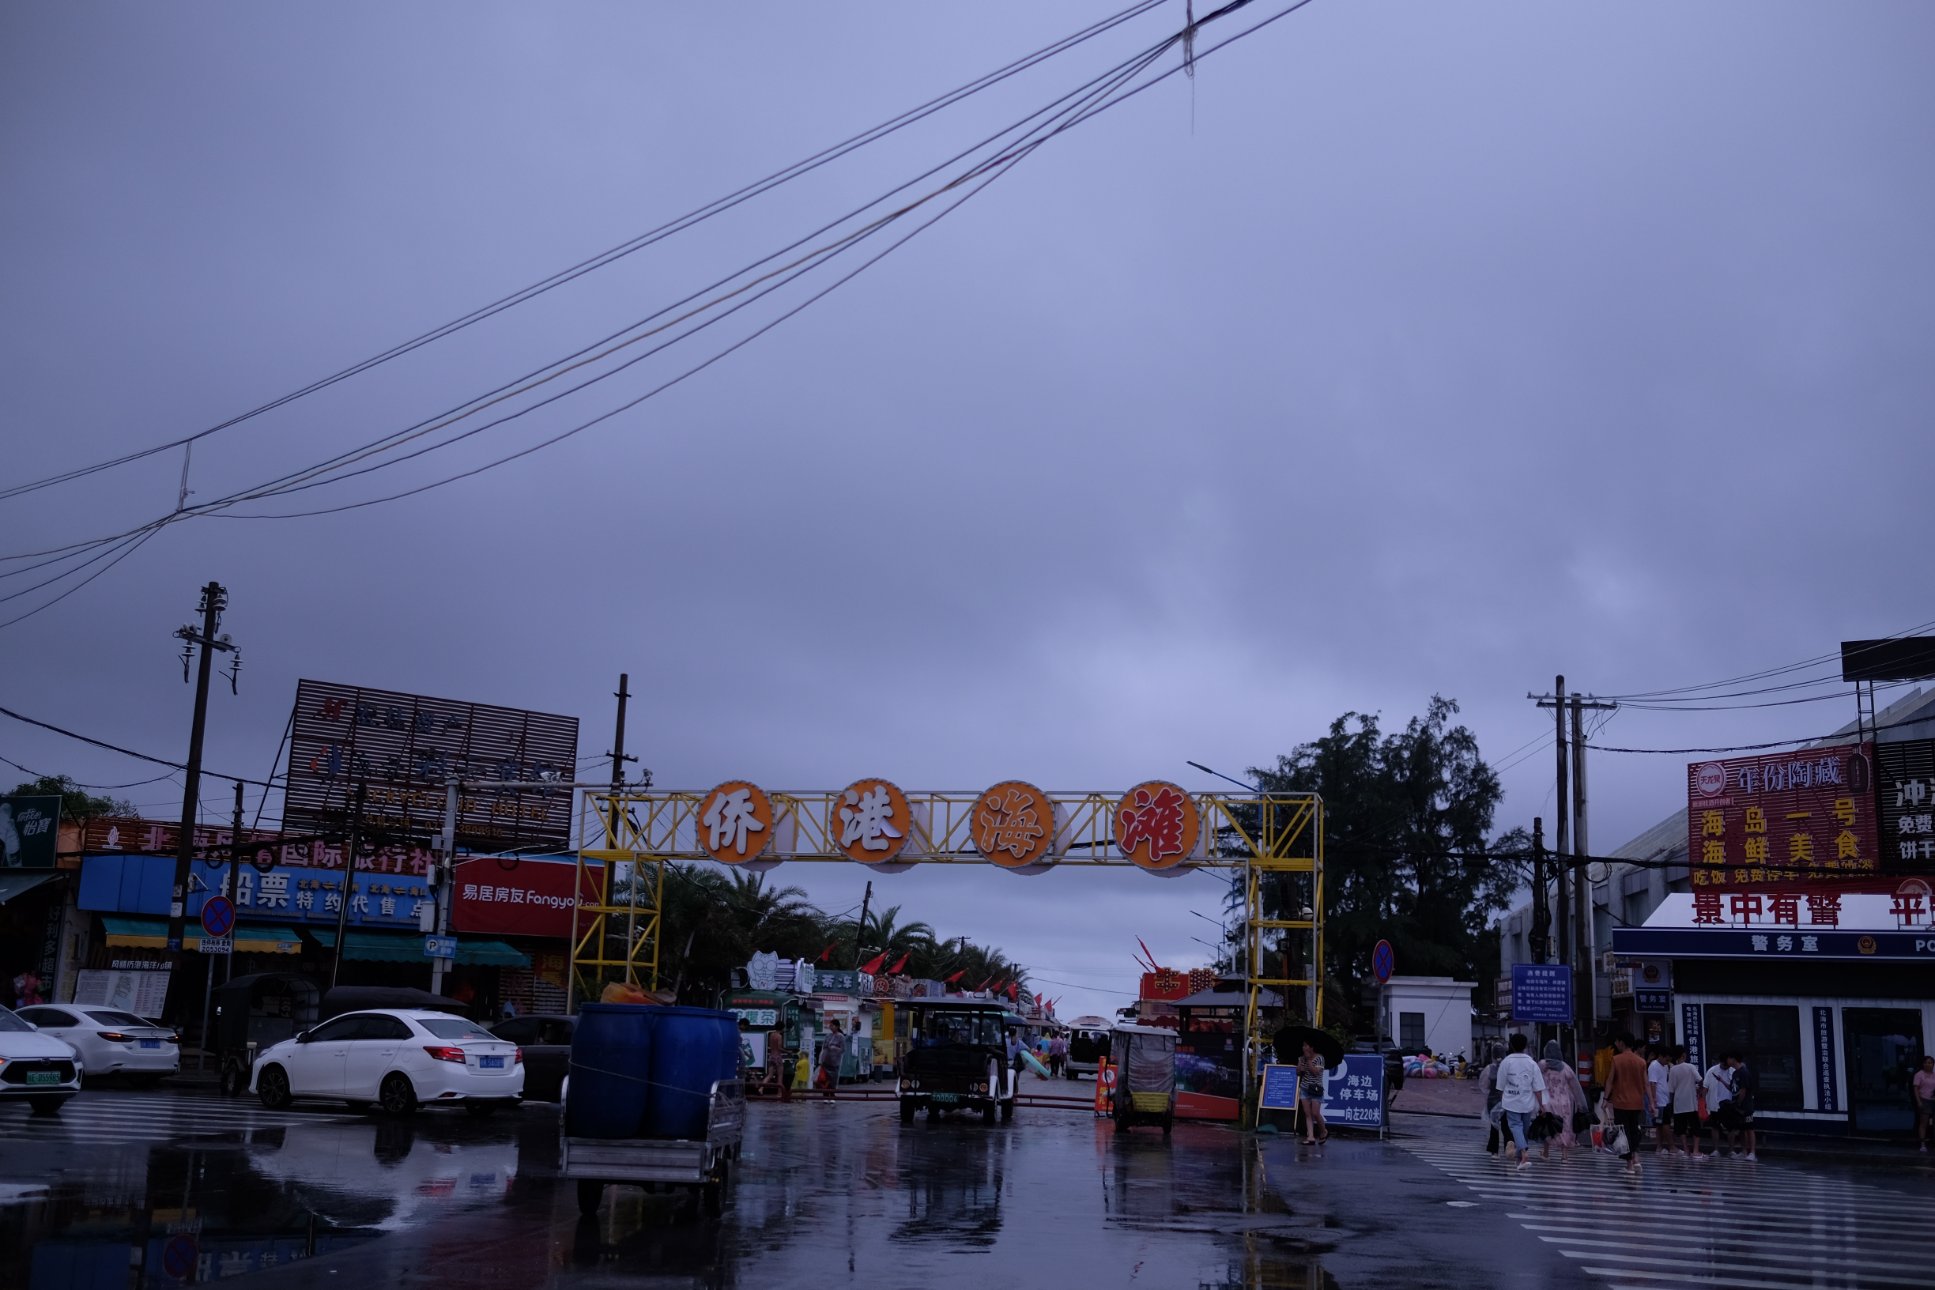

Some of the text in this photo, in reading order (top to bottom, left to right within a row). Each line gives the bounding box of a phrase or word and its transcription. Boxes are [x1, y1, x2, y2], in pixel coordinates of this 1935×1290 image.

[1737, 757, 1841, 794] 年份陶藏
[703, 786, 1184, 861] 侨港海滩
[1702, 798, 1858, 837] 海岛一号
[1899, 814, 1934, 834] 免费
[1703, 830, 1860, 864] 海鲜美食
[1693, 869, 1727, 886] 吃饭
[219, 871, 290, 908] 船票
[462, 884, 525, 904] 易居房友
[1692, 890, 1935, 927] 景中有警 平
[1751, 934, 1819, 952] 警务室
[1348, 1075, 1373, 1088] 海边
[1340, 1088, 1379, 1102] 停车场
[1345, 1107, 1380, 1122] 向左220米
